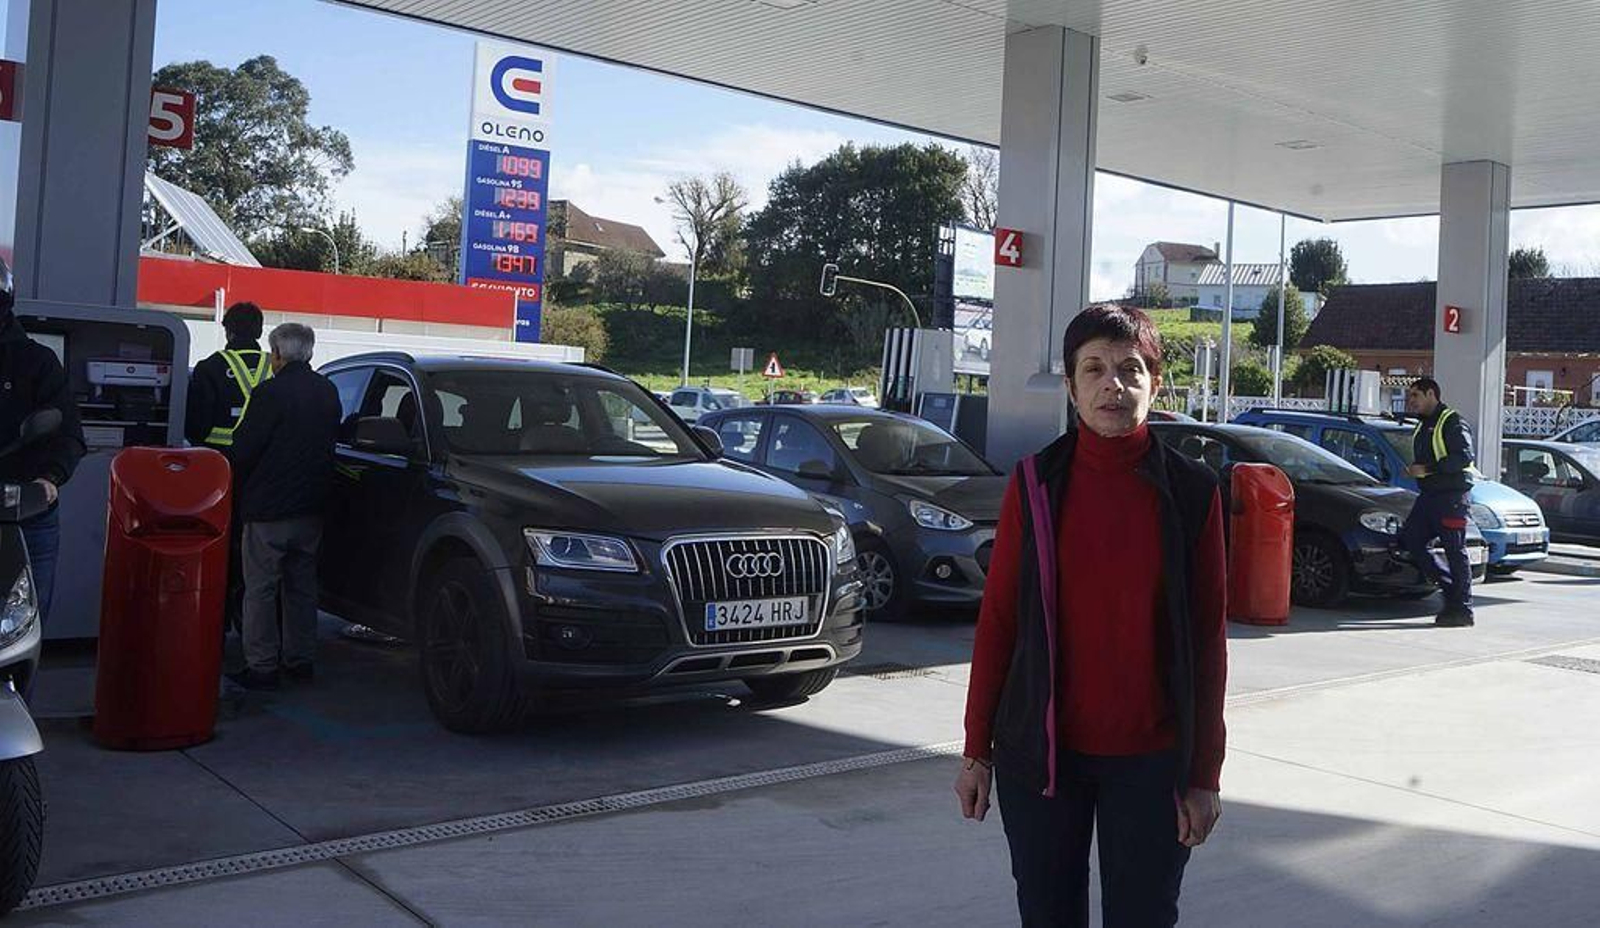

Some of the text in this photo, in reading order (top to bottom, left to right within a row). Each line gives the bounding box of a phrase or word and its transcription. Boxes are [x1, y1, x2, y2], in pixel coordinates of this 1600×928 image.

[148, 91, 185, 140] 5
[482, 122, 544, 142] OLENO
[475, 176, 523, 189] GASOLINA 95
[472, 242, 507, 252] GASOLINA
[999, 232, 1020, 264] 4
[1448, 308, 1459, 332] 2
[718, 600, 804, 625] 3424 HRJ
